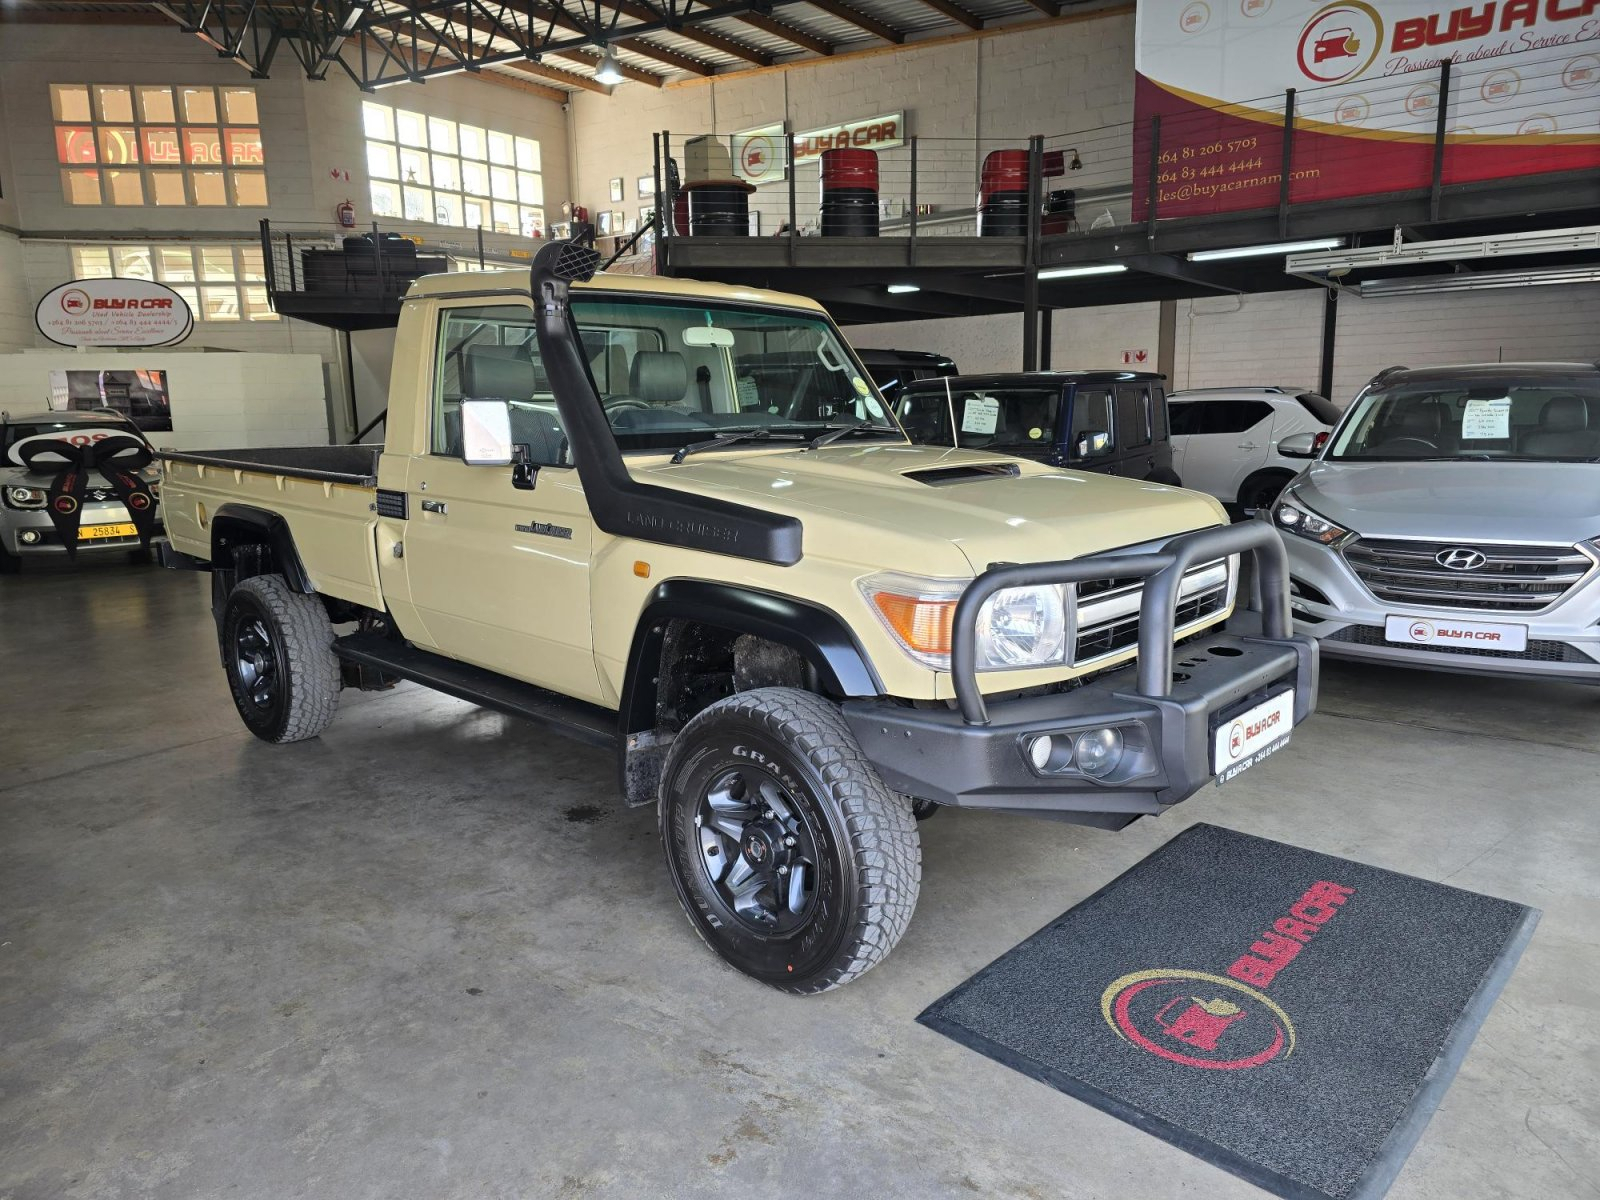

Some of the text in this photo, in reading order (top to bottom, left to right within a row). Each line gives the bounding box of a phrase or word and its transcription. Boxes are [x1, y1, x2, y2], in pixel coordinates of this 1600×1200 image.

[1390, 1, 1497, 54] BUY
[1499, 0, 1539, 32] A
[1466, 40, 1508, 61] about
[1510, 31, 1570, 54] Service
[190, 142, 208, 162] A
[794, 121, 897, 158] BUY A CAR
[1156, 137, 1257, 164] 264 81 206 5703
[1156, 157, 1263, 183] 264 83 444 4444
[1145, 169, 1321, 205] sles@buyacarnamcom
[93, 298, 173, 309] BUY A CAR
[93, 525, 121, 537] 25834
[1437, 629, 1501, 641] BUY A CAR
[1246, 711, 1280, 740] BUY A CAR
[674, 802, 724, 930] DUNLOP
